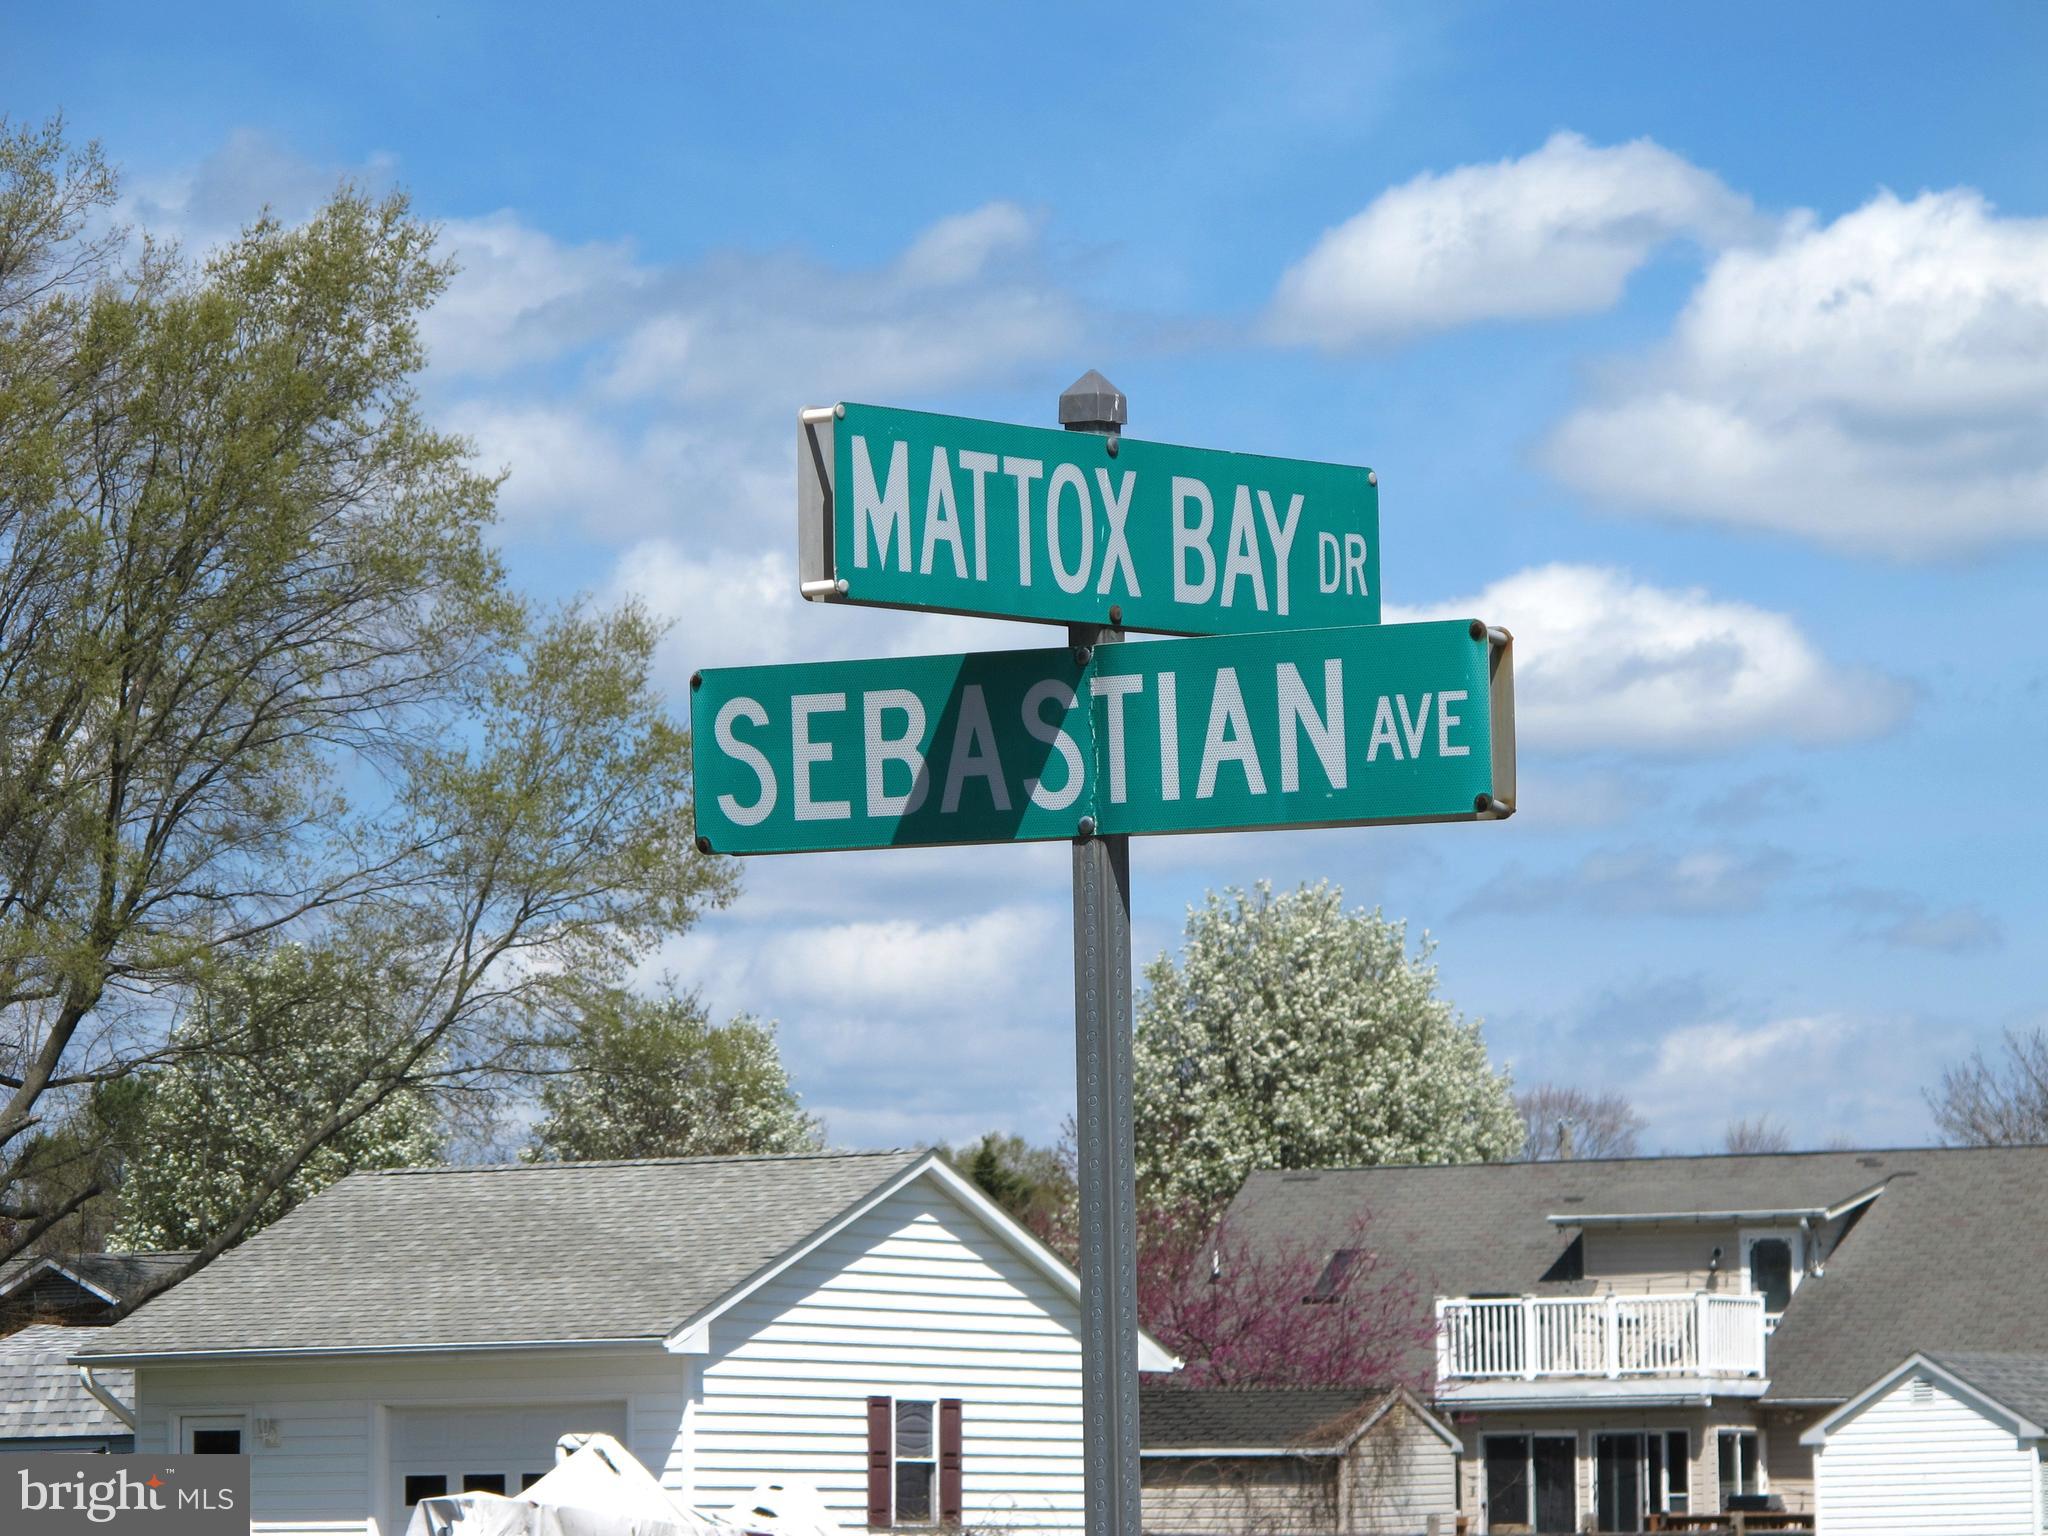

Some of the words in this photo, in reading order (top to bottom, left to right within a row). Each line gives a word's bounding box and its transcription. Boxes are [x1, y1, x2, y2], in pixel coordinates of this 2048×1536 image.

[850, 435, 1142, 599] MATTOX
[1171, 475, 1305, 616] BAY
[1318, 531, 1369, 597] DR
[713, 658, 1348, 827] SEBASTIAN
[1366, 689, 1471, 763] AVE
